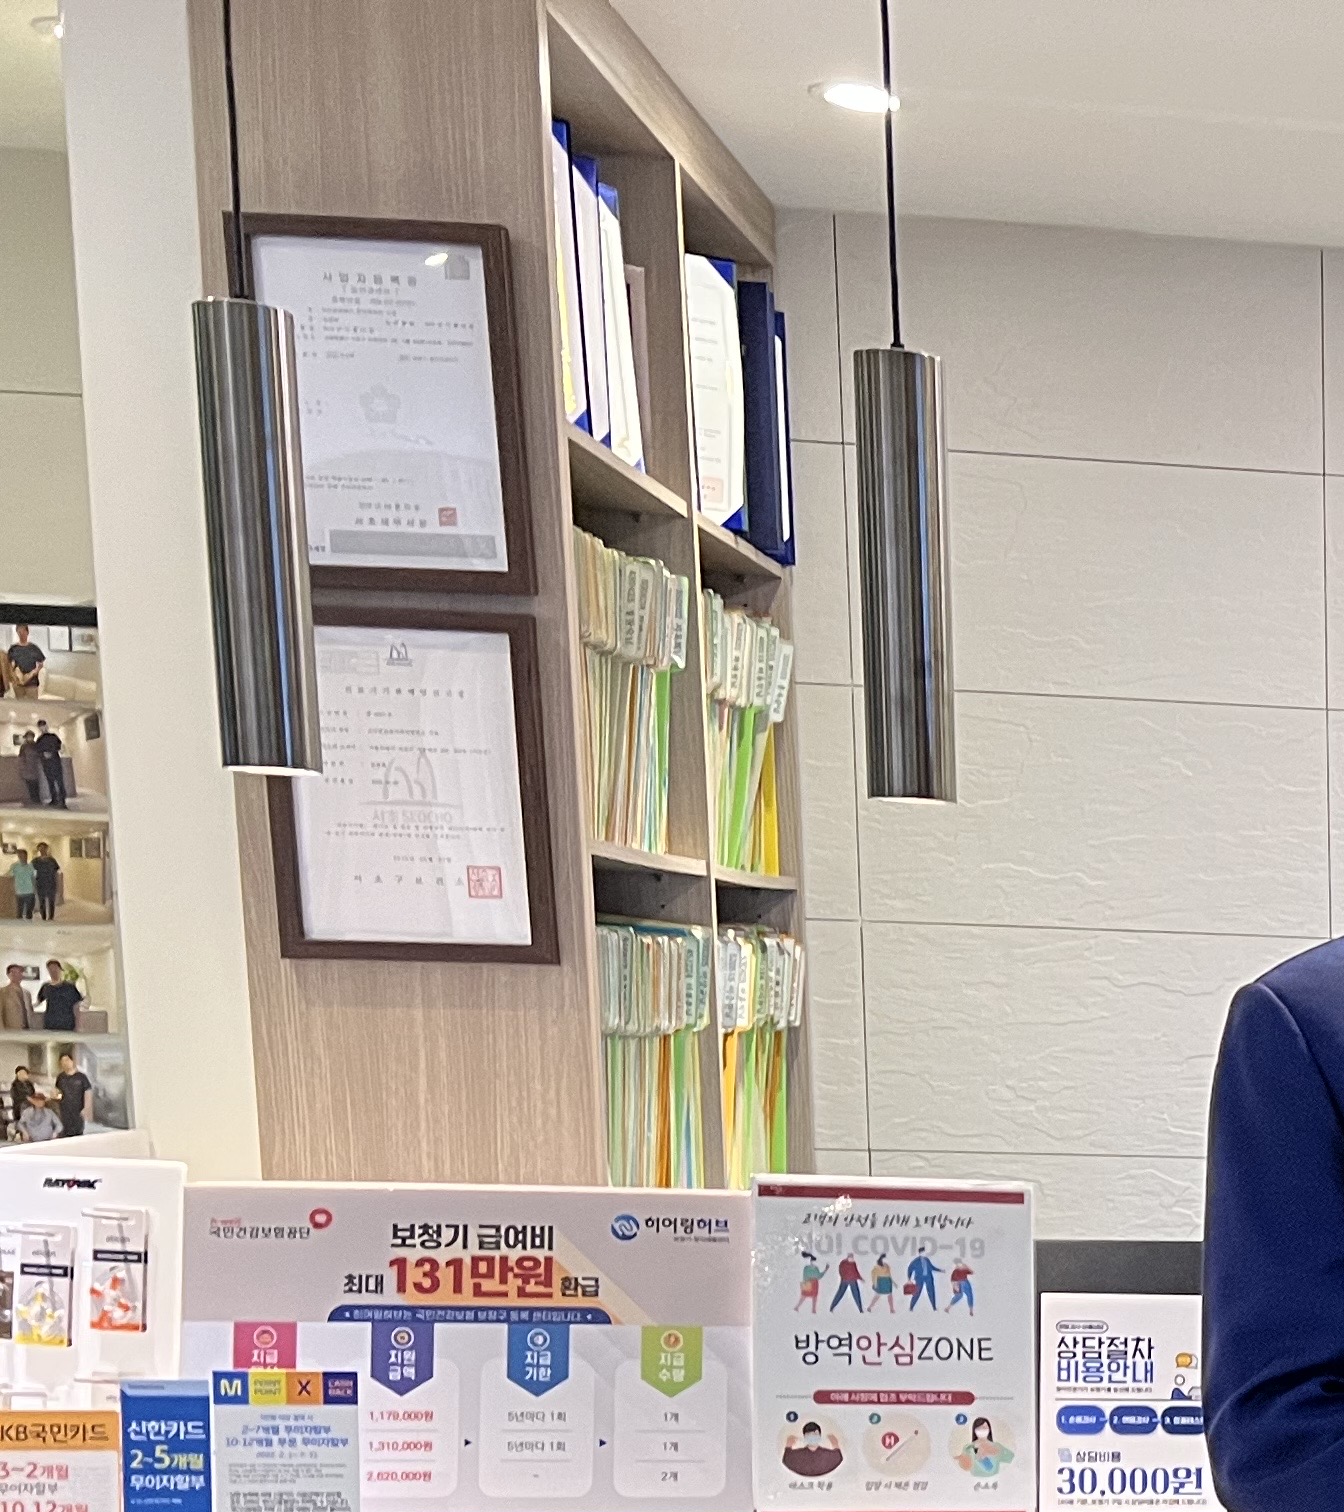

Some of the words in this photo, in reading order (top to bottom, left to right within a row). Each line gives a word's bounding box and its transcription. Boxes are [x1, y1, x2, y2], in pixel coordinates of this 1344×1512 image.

[209, 1226, 310, 1239] 국민건강보험공단
[390, 1223, 468, 1249] 보청기
[477, 1224, 554, 1251] 급여비
[645, 1216, 730, 1234] 히어링허브
[852, 1234, 985, 1259] COVID-19
[343, 1273, 384, 1294] 최대
[389, 1255, 553, 1298] 131만원
[560, 1276, 600, 1298] 환급
[794, 1331, 994, 1366] 방역안심ZONE
[1057, 1336, 1154, 1360] 상담절차
[1057, 1360, 1154, 1384] 비용안내
[220, 1379, 241, 1397] M
[297, 1380, 311, 1396] X
[0, 1422, 110, 1444] KB국민카드
[128, 1419, 206, 1441] 신한카드
[130, 1444, 204, 1471] 2~5개월
[130, 1474, 205, 1490] 무이자할부
[1057, 1467, 1203, 1497] 30,000원
